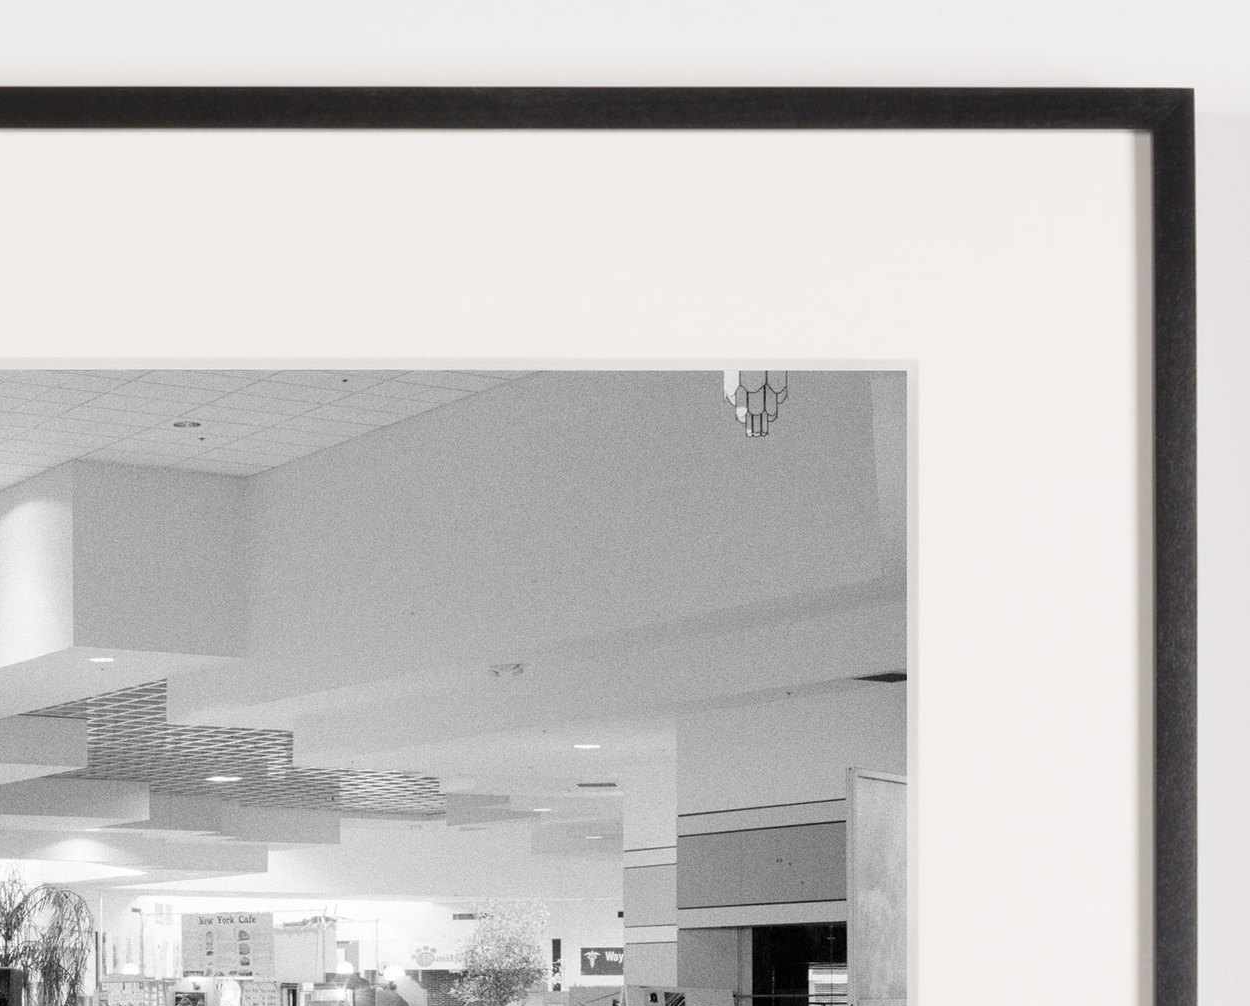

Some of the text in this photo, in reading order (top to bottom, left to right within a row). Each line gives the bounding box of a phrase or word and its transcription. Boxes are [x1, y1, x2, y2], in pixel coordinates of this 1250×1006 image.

[198, 915, 257, 925] New York Cafe
[605, 951, 624, 964] Way
